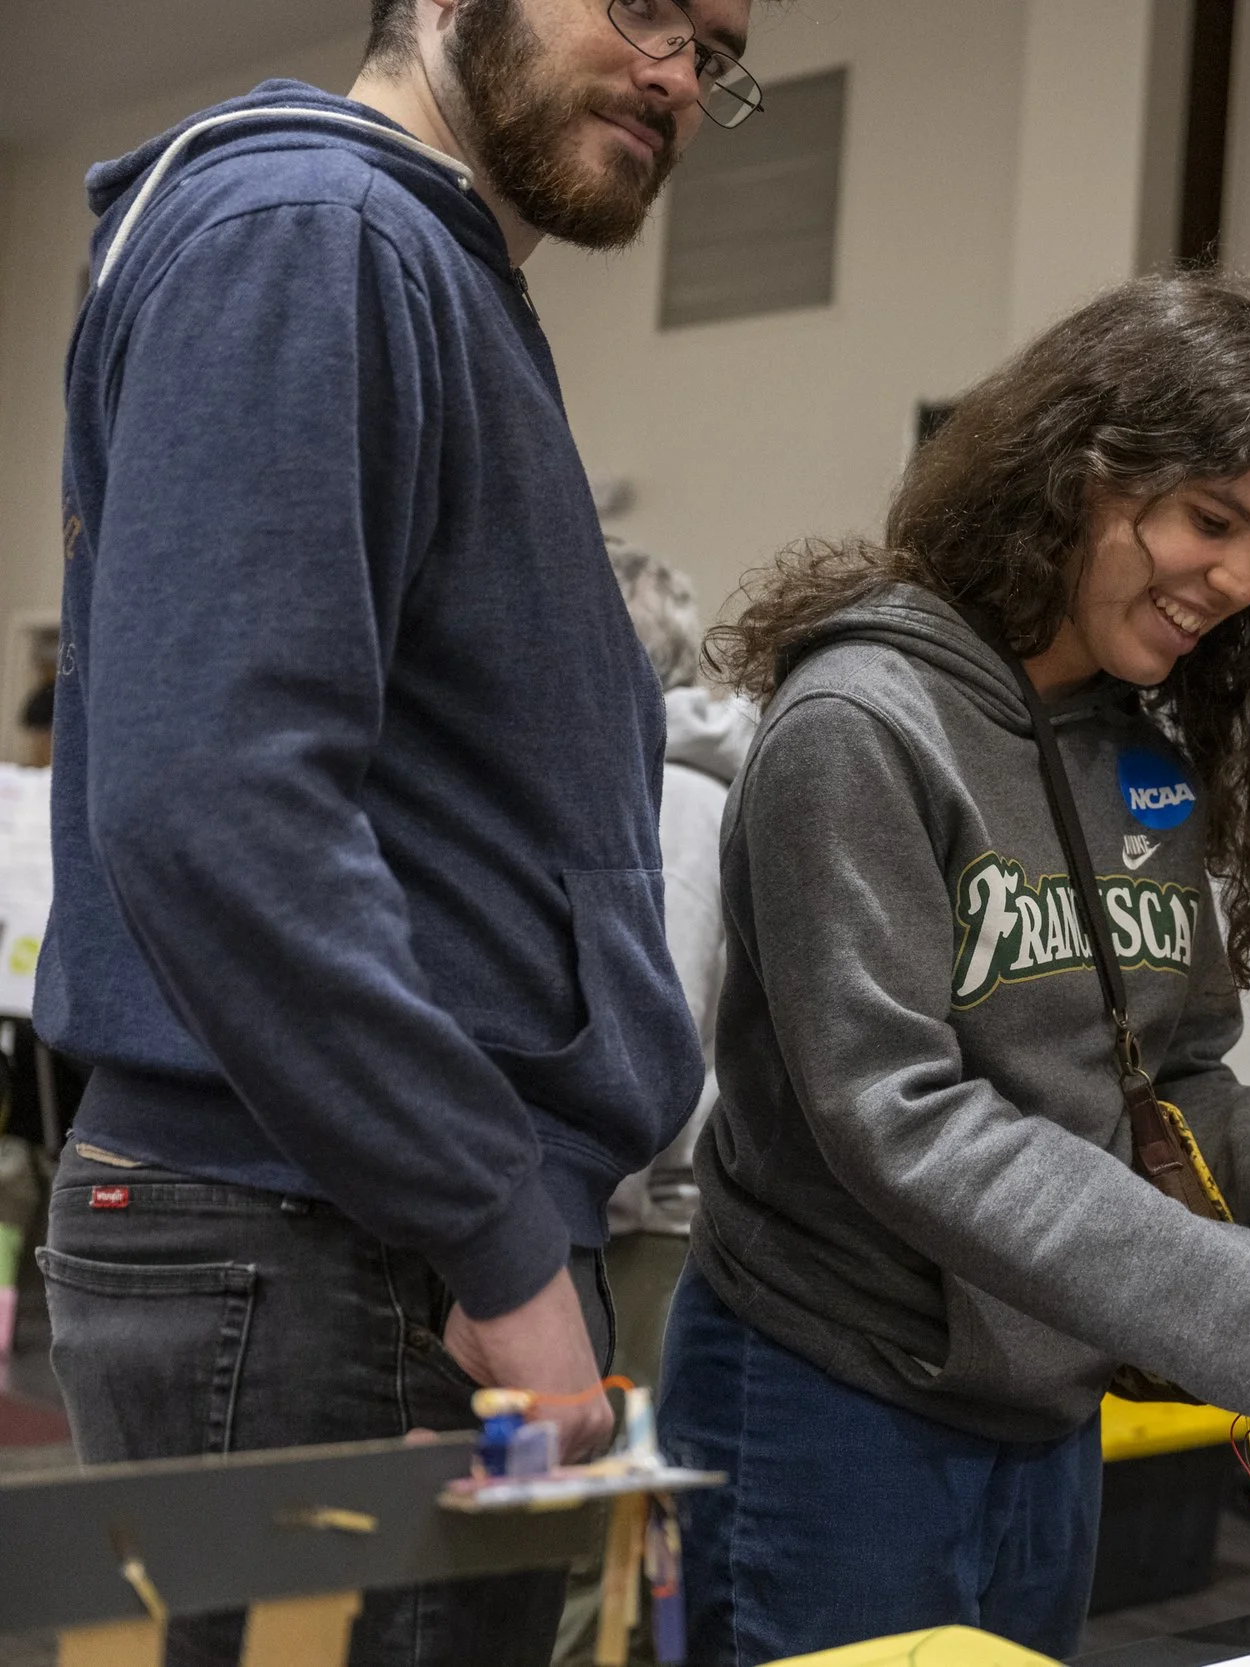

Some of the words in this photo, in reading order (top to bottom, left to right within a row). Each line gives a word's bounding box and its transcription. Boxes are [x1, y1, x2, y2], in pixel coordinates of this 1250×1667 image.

[1129, 782, 1196, 811] NCAA
[1123, 834, 1150, 856] NIKE
[955, 863, 1199, 998] FRANCSCA
